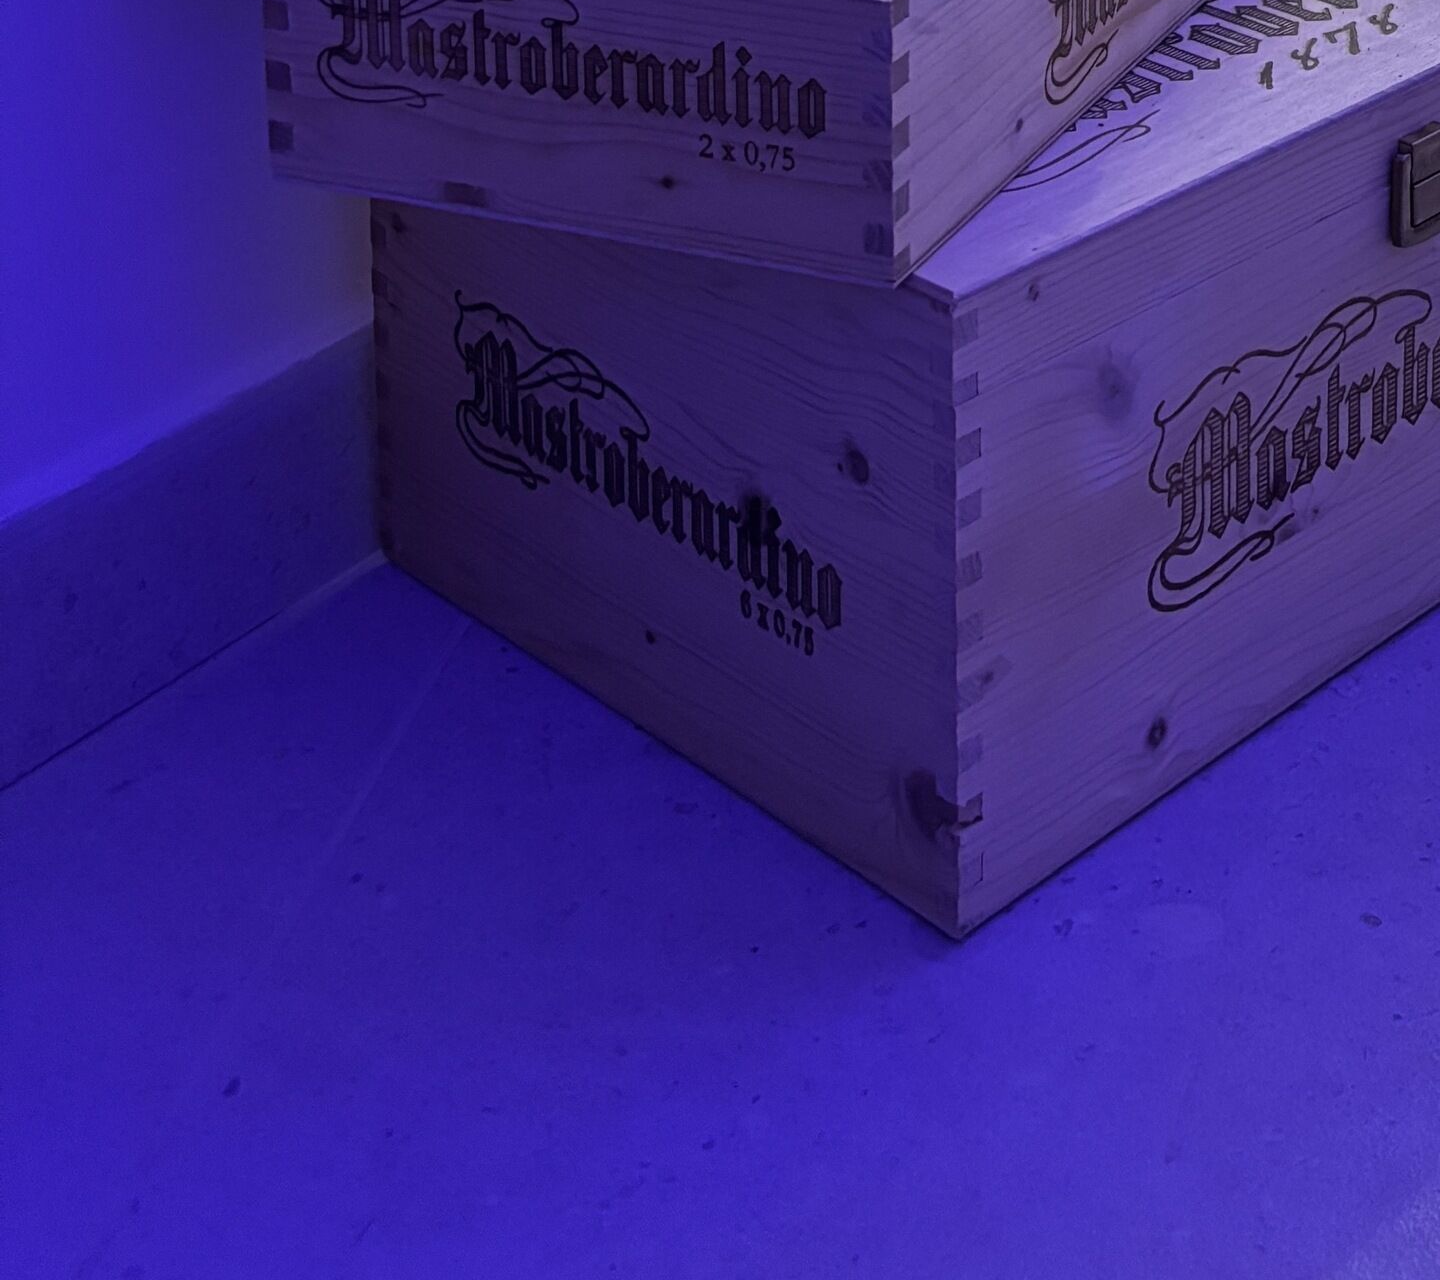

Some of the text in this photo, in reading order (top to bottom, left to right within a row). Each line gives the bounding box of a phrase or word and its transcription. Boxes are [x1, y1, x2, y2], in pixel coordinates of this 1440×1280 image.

[1258, 3, 1399, 89] 1878
[699, 133, 796, 172] 2 x 0,75
[454, 290, 842, 630] Mastroberardino
